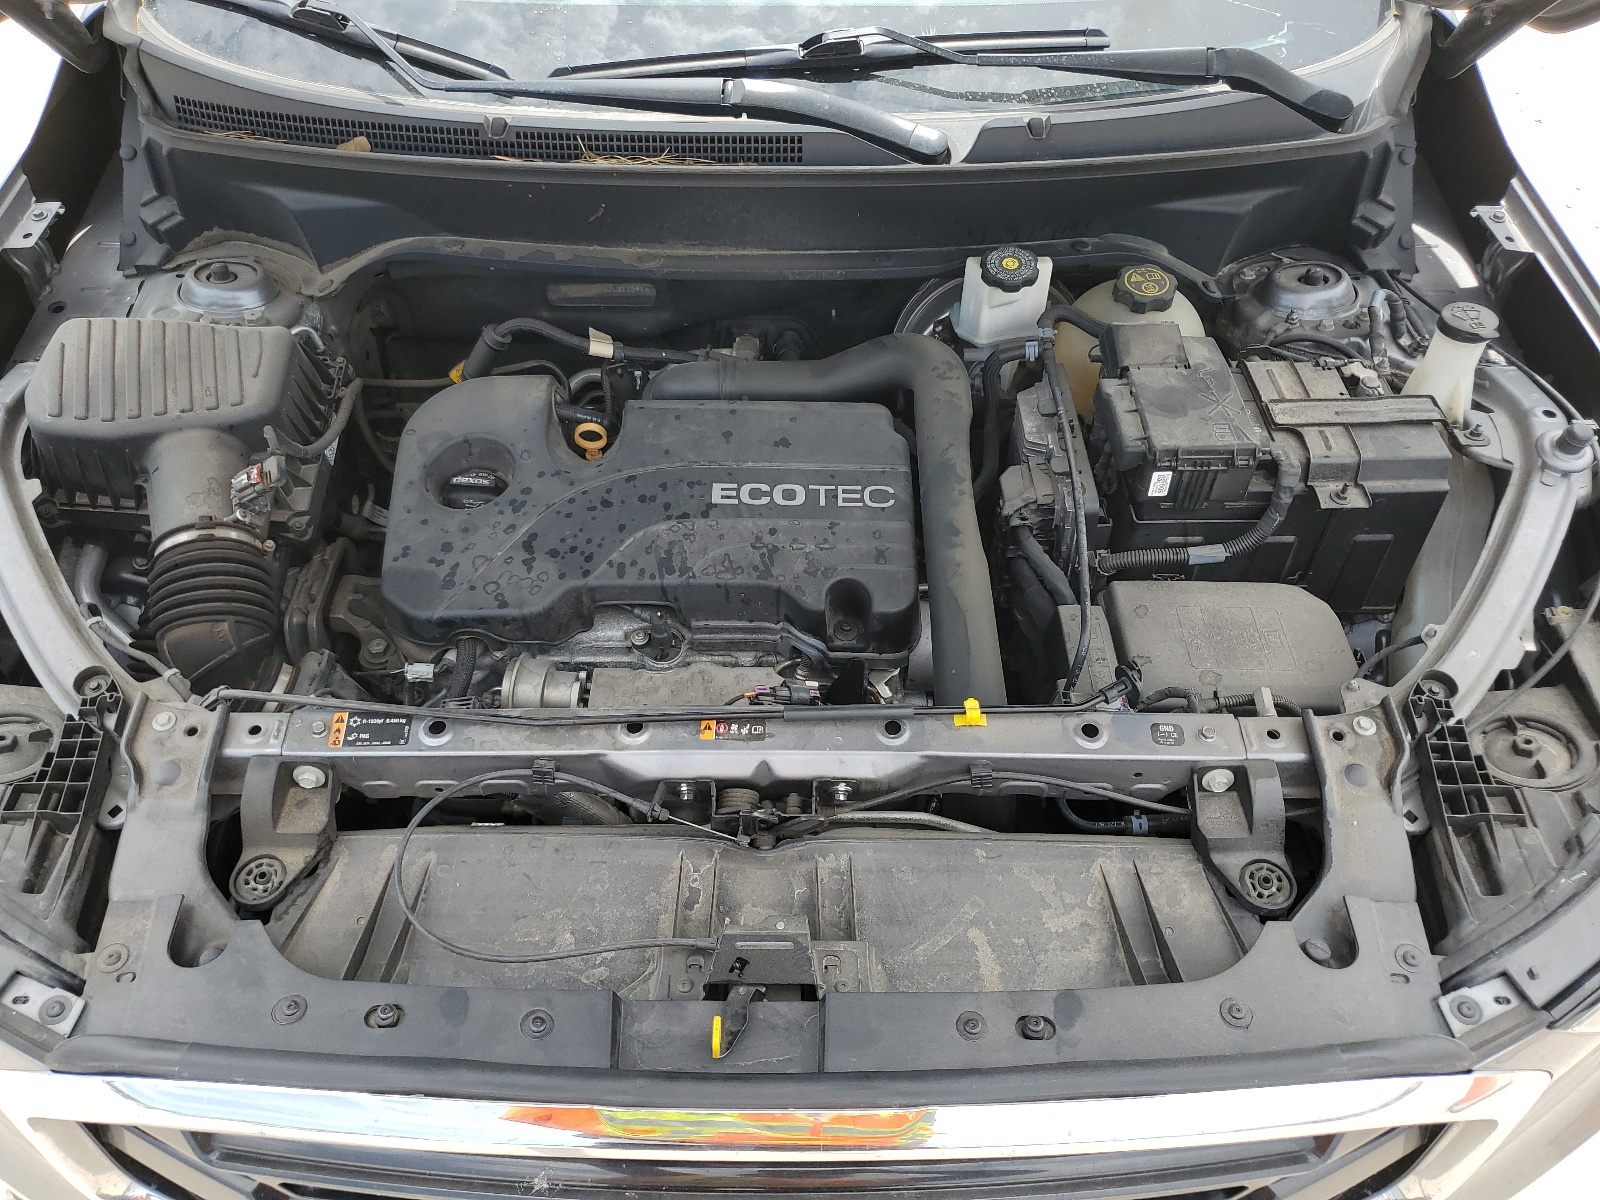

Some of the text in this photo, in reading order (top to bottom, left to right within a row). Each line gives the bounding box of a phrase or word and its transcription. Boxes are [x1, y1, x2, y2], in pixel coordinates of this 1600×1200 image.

[452, 475, 491, 485] dexos
[711, 482, 895, 508] ECOTEC
[1159, 724, 1174, 732] GND
